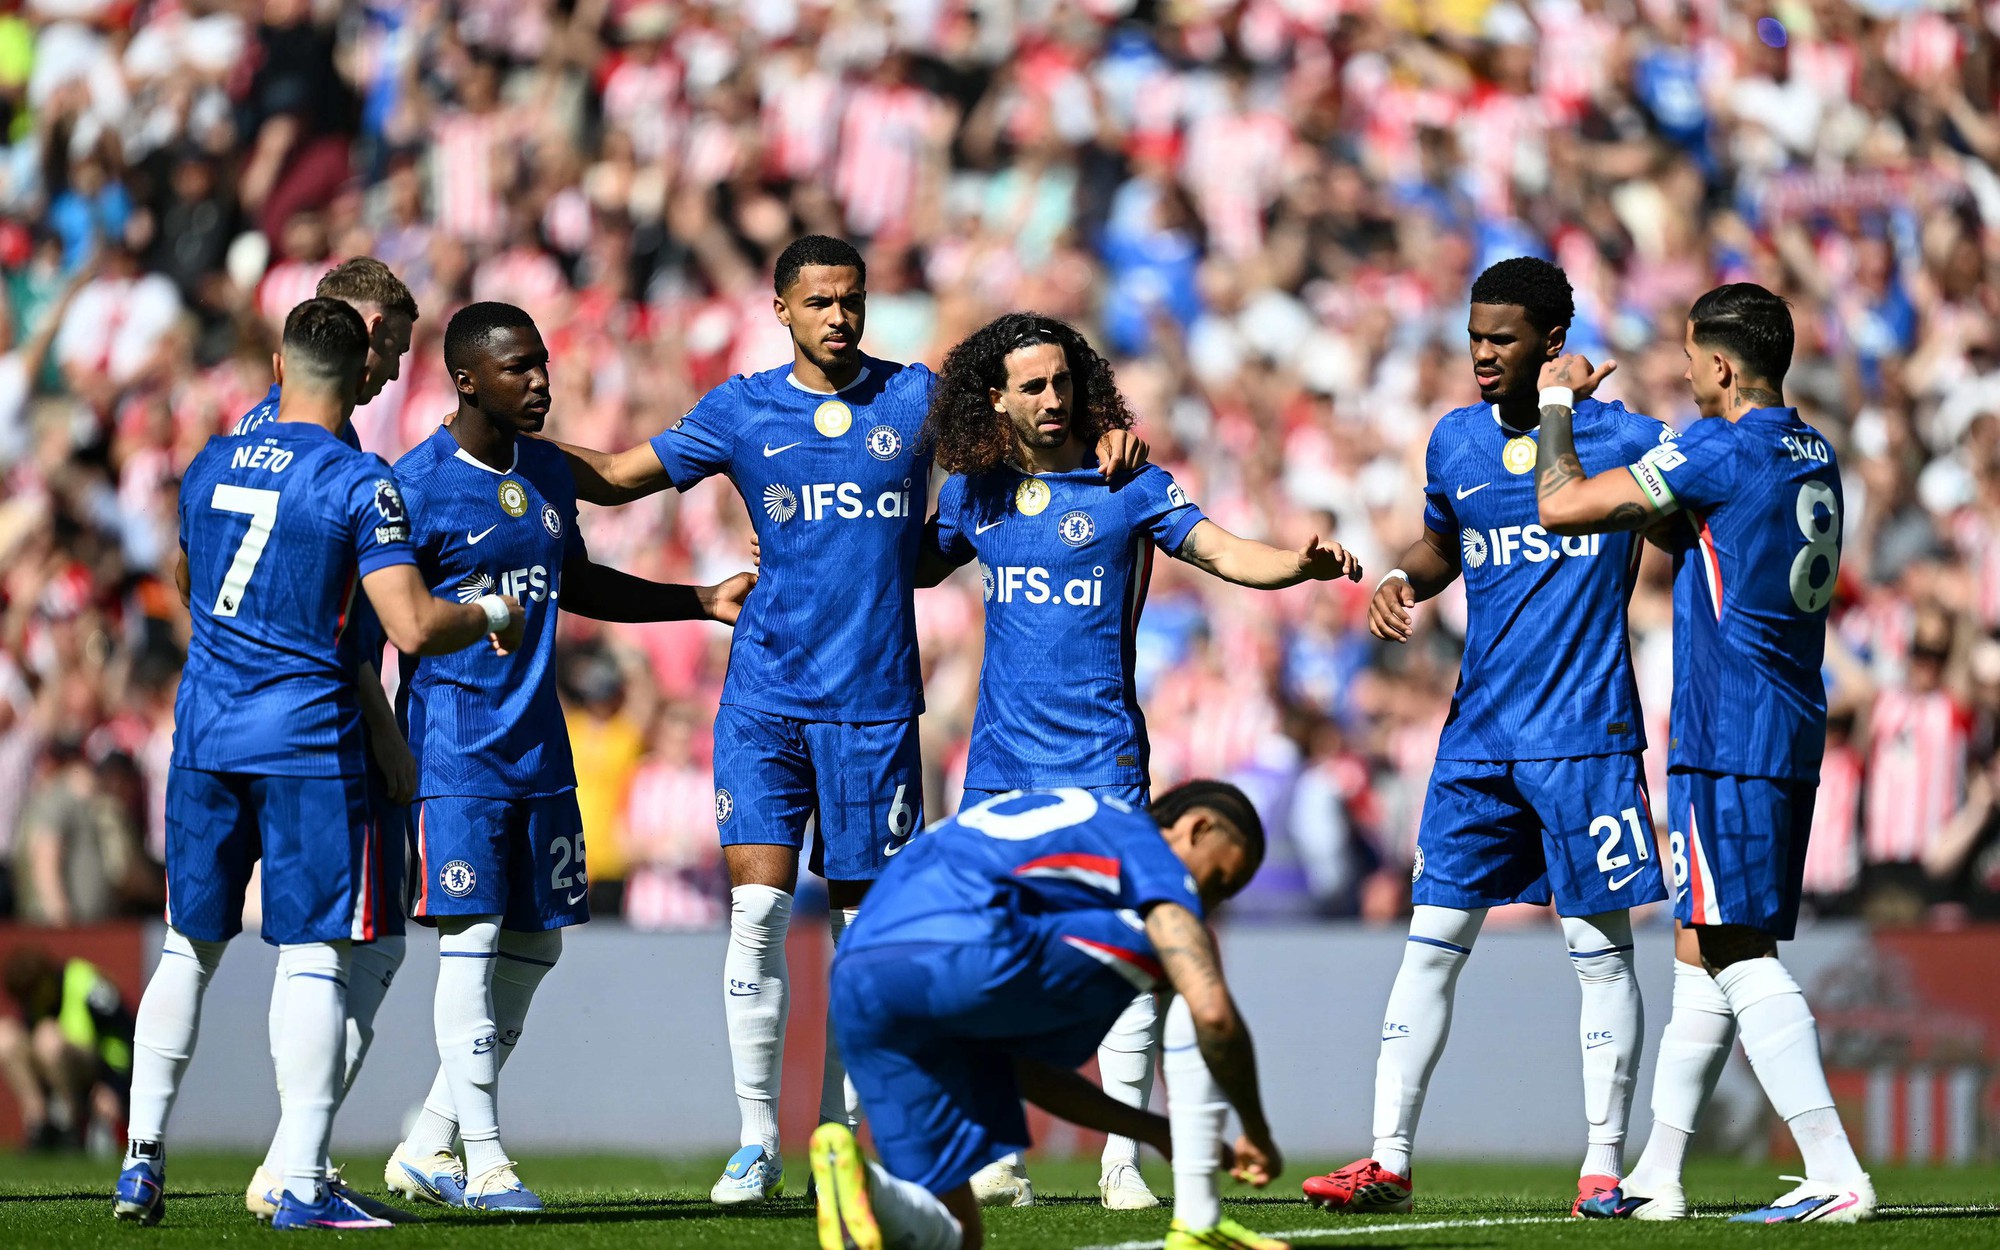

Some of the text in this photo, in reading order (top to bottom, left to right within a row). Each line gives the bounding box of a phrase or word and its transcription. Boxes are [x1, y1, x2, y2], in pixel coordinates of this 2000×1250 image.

[230, 445, 294, 474] NETO
[1781, 436, 1829, 464] ENZO
[801, 477, 912, 521] IFS.ai
[1636, 461, 1662, 497] ptain
[210, 483, 280, 617] 7
[1488, 523, 1600, 566] IFS.ai
[1789, 480, 1839, 613] 8
[502, 564, 562, 606] IFS.
[996, 565, 1104, 606] IFS.ai
[888, 784, 912, 837] 6
[925, 787, 1099, 841] 0
[549, 832, 588, 890] 25
[1588, 806, 1649, 873] 21
[1669, 831, 1688, 887] 8
[730, 978, 761, 990] CFC
[1384, 1021, 1410, 1033] CFC
[1587, 1030, 1613, 1041] CFC
